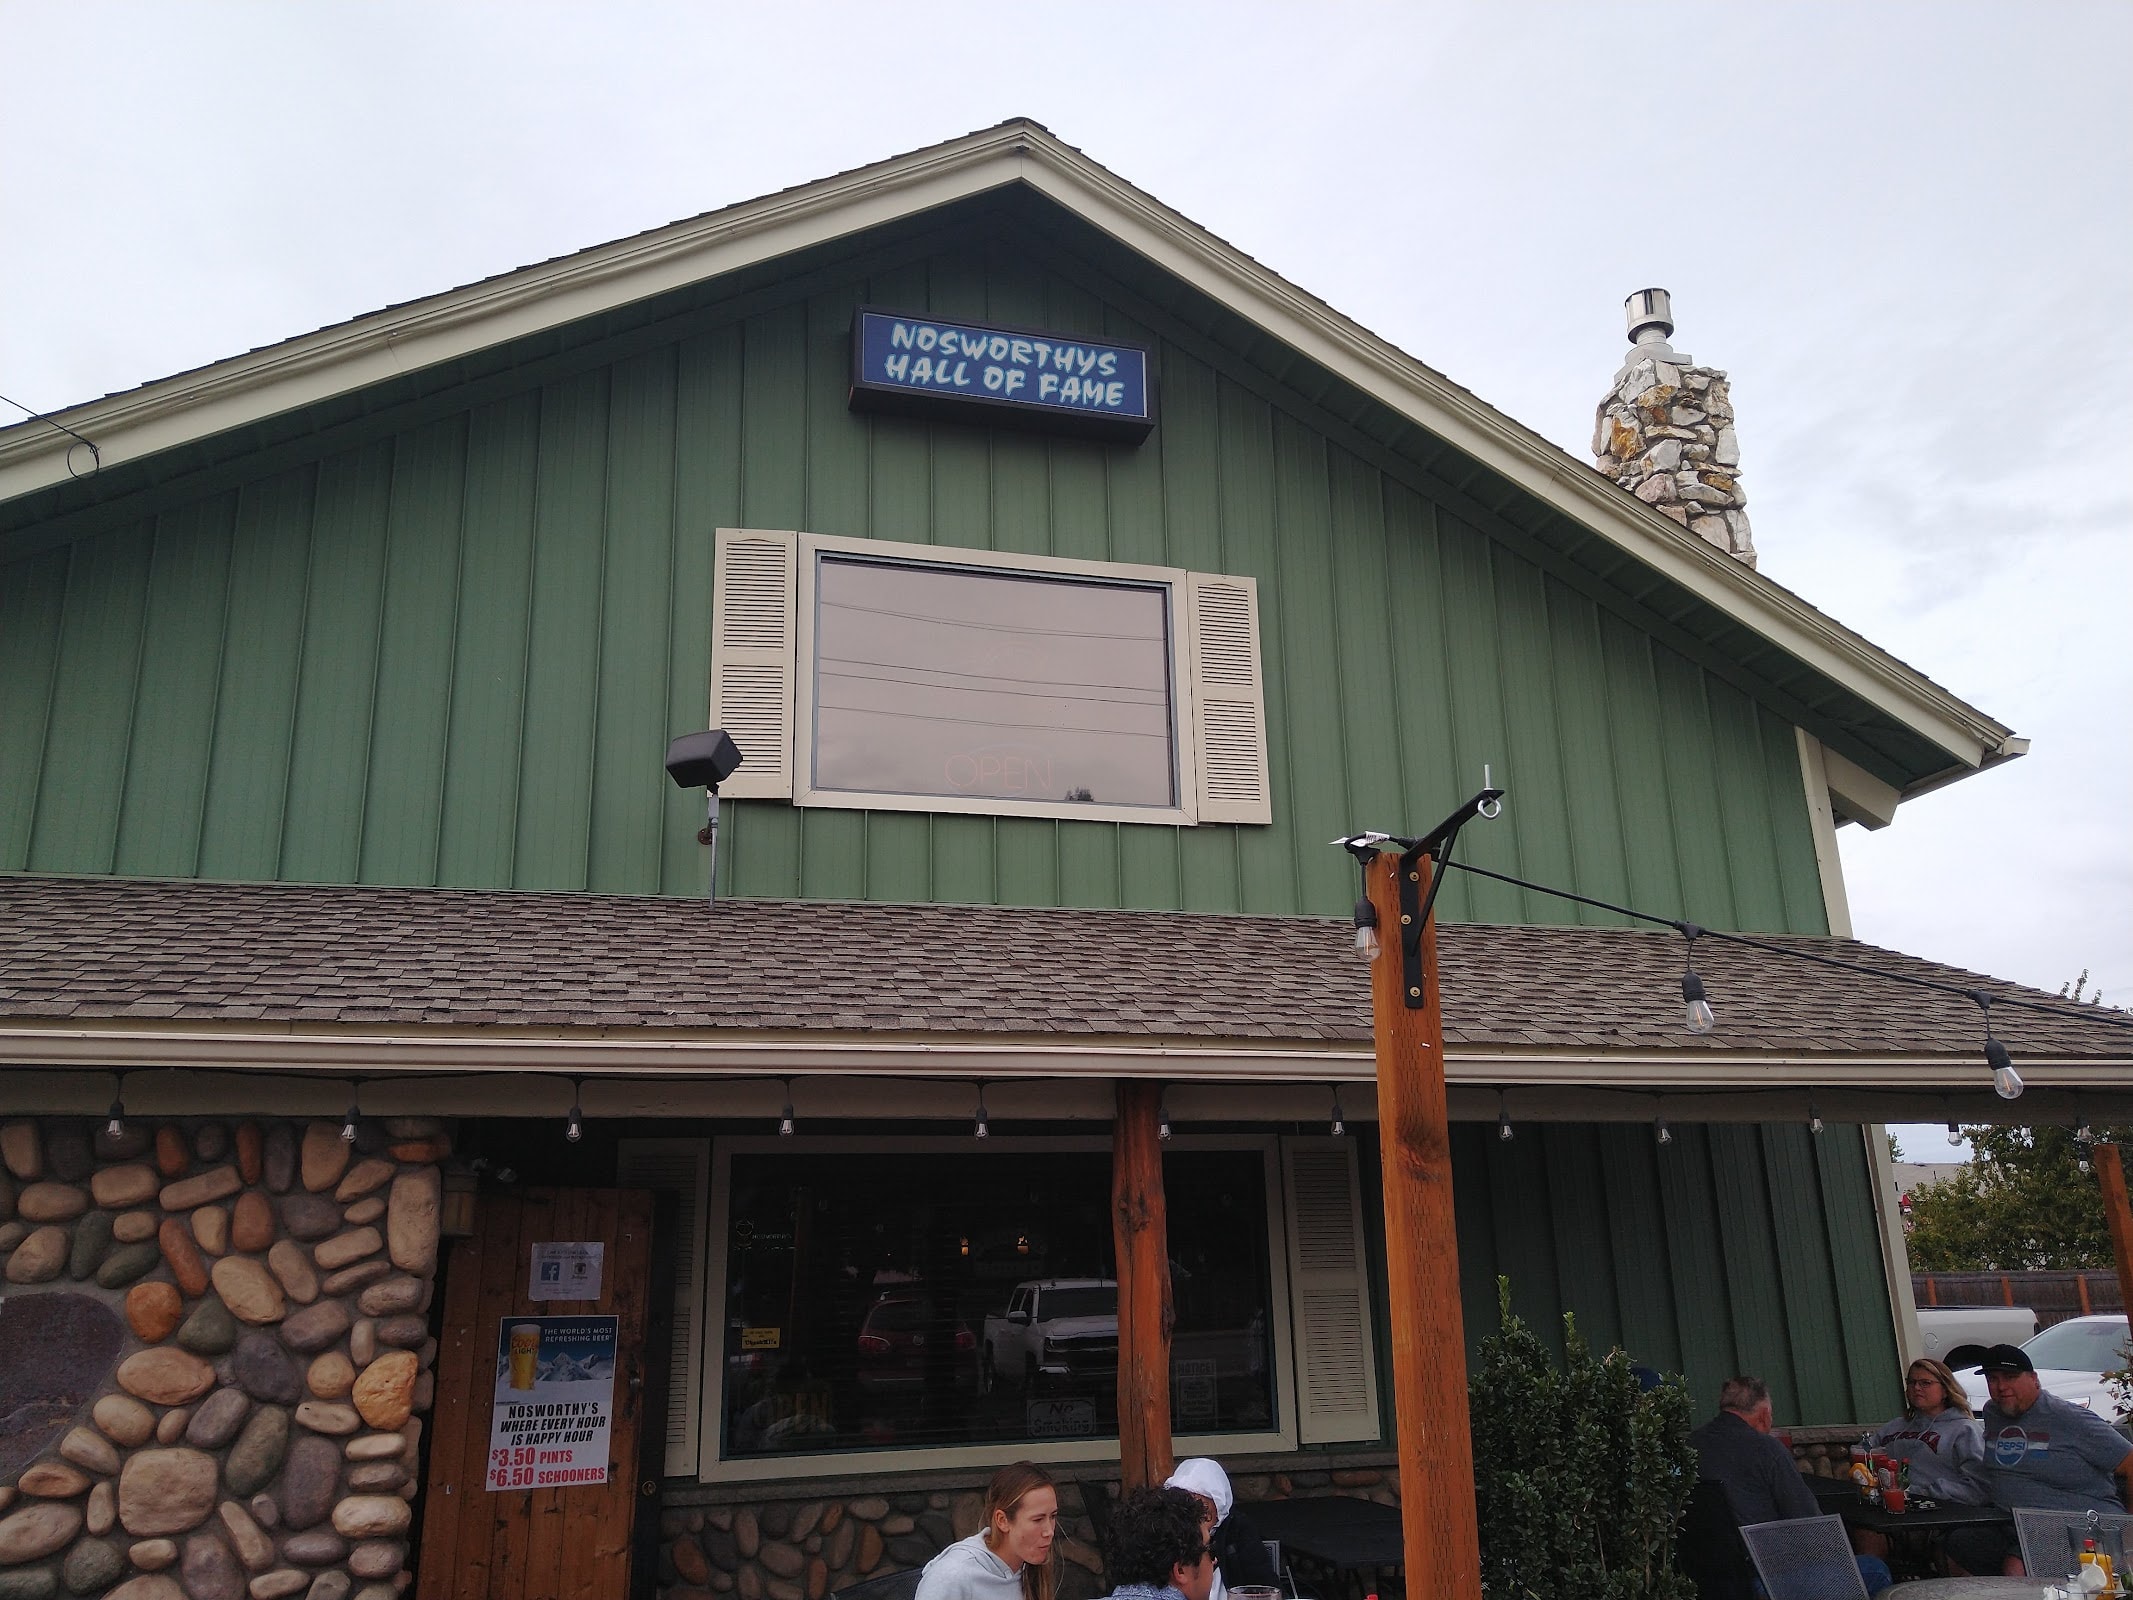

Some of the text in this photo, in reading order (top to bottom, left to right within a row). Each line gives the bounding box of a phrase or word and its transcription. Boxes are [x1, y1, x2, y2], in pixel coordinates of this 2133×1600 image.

[891, 322, 1118, 376] NOSWORTHYS
[884, 353, 1125, 407] HALL OF FAME
[944, 754, 1051, 790] OPEN
[560, 1327, 591, 1335] WORLD'S
[508, 1402, 599, 1419] NOSWORTHY'S
[1049, 1403, 1074, 1415] No
[500, 1416, 606, 1433] WHERE EVERY HOUR
[1033, 1418, 1089, 1434] Smoking
[511, 1430, 594, 1446] IS HAPPY HOUR
[1997, 1441, 2026, 1451] PEPSI
[491, 1447, 573, 1467] $3.50 PINTS
[489, 1467, 605, 1487] $6.50 SCHOONERS
